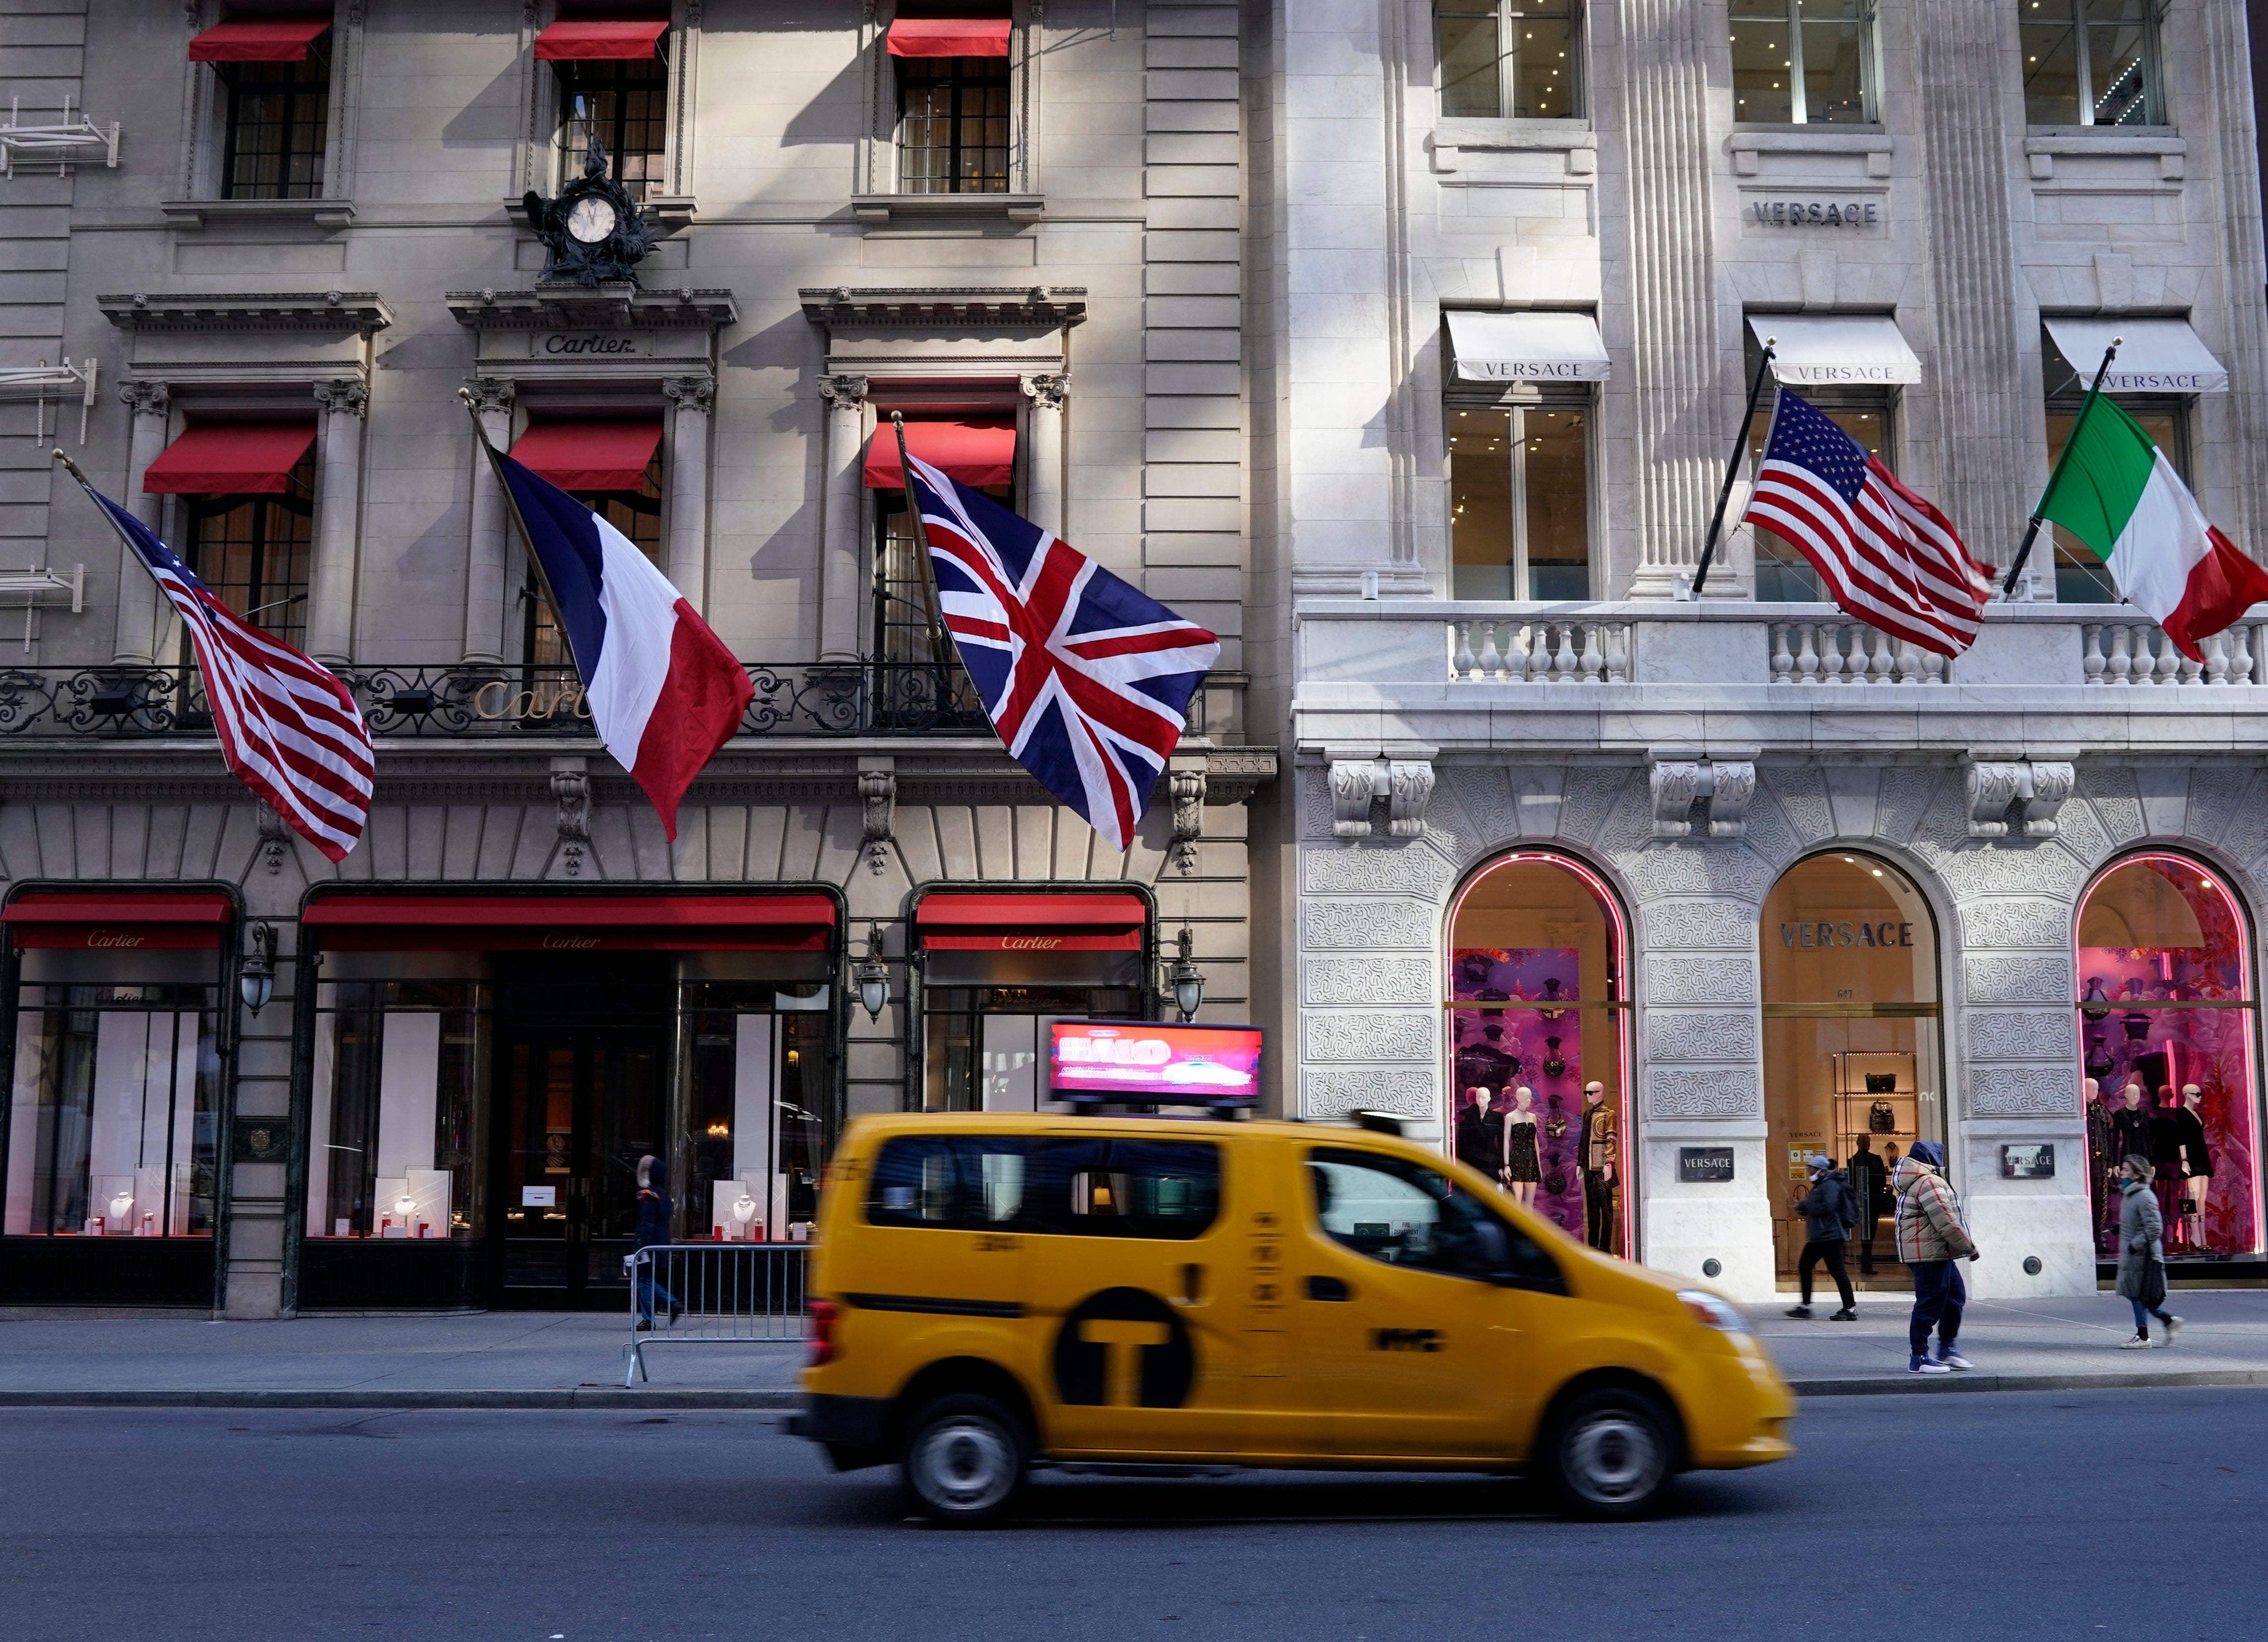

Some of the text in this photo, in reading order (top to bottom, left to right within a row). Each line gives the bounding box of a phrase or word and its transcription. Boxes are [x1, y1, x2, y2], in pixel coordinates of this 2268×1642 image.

[1753, 201, 1877, 223] VERSACE
[546, 334, 631, 353] Cartier
[1486, 363, 1582, 376] VERSACE
[1799, 367, 1893, 380] VERSACE
[2106, 375, 2202, 388] VERSACE
[475, 681, 591, 719] Cart
[87, 929, 144, 946] Cartier
[543, 930, 600, 948] Cartier
[1002, 931, 1061, 948] Cartier
[1780, 922, 1914, 947] VERSACE
[1838, 988, 1853, 998] 647
[1685, 1159, 1731, 1168] VERSACE
[2006, 1156, 2052, 1165] VERSACE
[2162, 1214, 2204, 1223] RSACE
[1079, 1319, 1172, 1407] T
